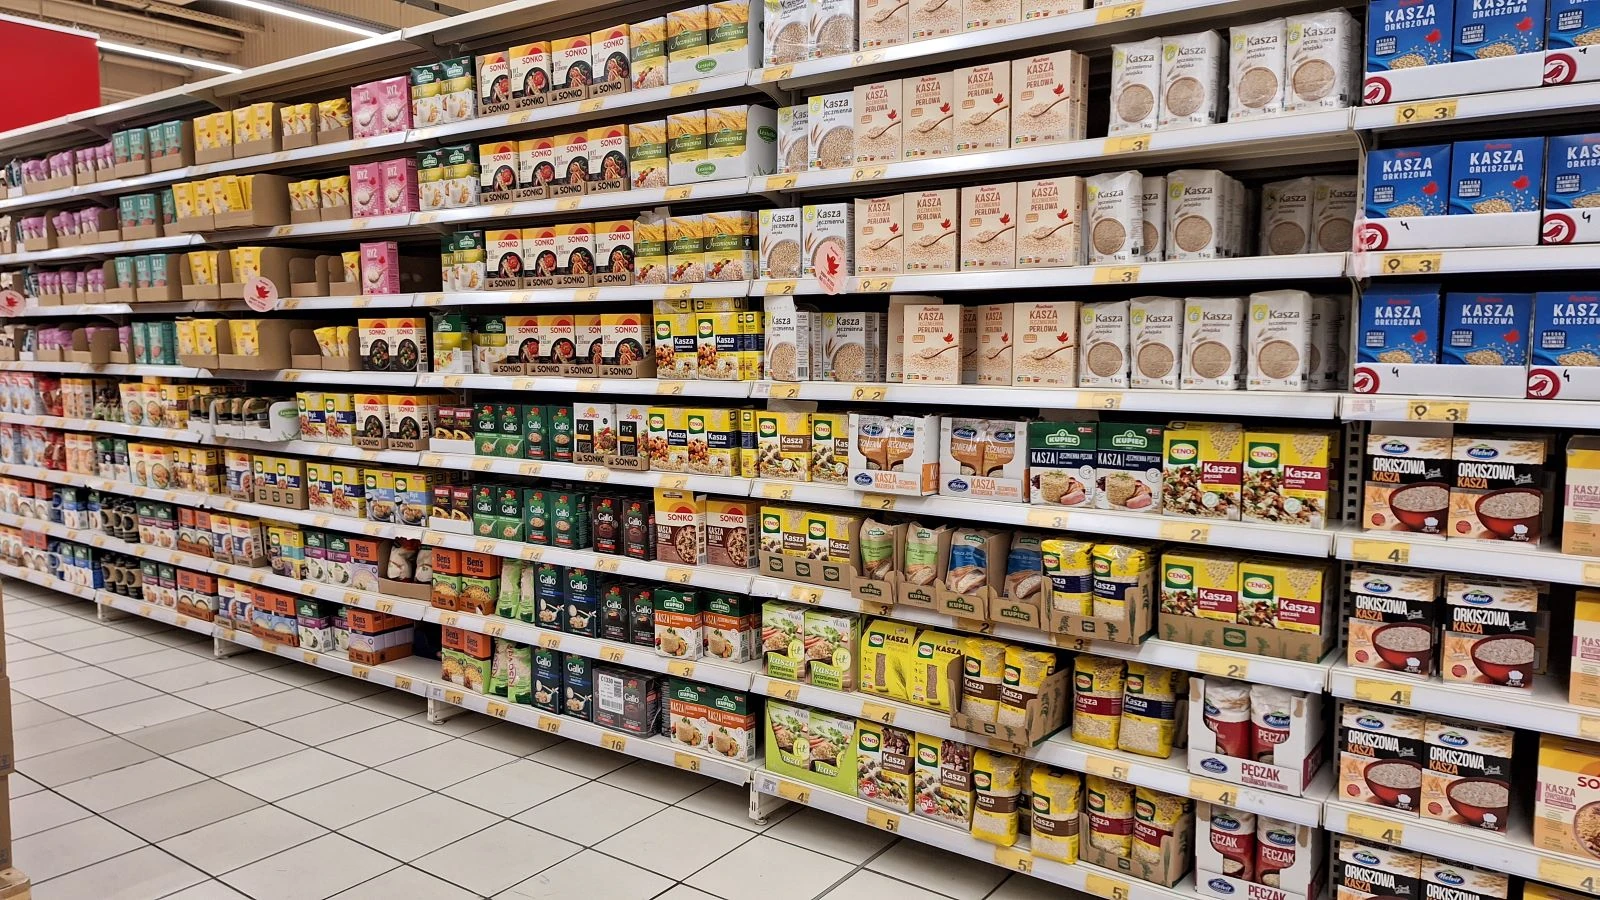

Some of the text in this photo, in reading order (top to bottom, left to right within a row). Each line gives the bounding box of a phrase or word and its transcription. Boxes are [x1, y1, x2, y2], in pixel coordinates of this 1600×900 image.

[1385, 4, 1435, 23] KASZA
[1385, 18, 1435, 31] ORKISZOWA
[1303, 27, 1336, 37] Kasza
[603, 39, 624, 49] SONKO
[1247, 35, 1278, 46] Kasza
[565, 48, 587, 57] SONKO
[1178, 47, 1206, 55] Kasza
[522, 56, 543, 65] SONKO
[1126, 54, 1154, 63] Kasza
[1027, 62, 1054, 74] KASZA
[916, 83, 940, 92] KASZA
[559, 89, 582, 100] SONKO
[824, 99, 848, 108] Kasza
[1434, 107, 1447, 119] 3
[601, 138, 622, 147] SONKO
[1132, 141, 1142, 150] 3
[1470, 150, 1523, 165] KASZA
[1383, 158, 1432, 172] KASZA
[1470, 163, 1523, 173] ORKISZOWA
[1383, 170, 1431, 180] ORKISZOWA
[1031, 188, 1058, 197] KASZA
[1184, 186, 1212, 195] Kasza
[917, 198, 941, 208] KASZA
[1419, 260, 1432, 272] 3
[1122, 272, 1132, 282] 3
[1030, 310, 1058, 320] KASZA
[1268, 310, 1300, 318] Kasza
[1375, 306, 1421, 318] KASZA
[1462, 304, 1514, 316] KASZA
[836, 316, 860, 326] Kasza
[918, 312, 944, 321] KASZA
[1095, 314, 1122, 322] Kasza
[1146, 314, 1173, 323] Kasza
[1202, 312, 1233, 320] Kasza
[1446, 409, 1459, 421] 3
[479, 421, 494, 431] Gallo
[555, 422, 568, 431] Gallo
[1171, 448, 1195, 456] CENOS
[1250, 450, 1276, 459] CENOS
[1203, 462, 1237, 474] Kasza
[1373, 457, 1426, 474] ORKISZOWA
[1285, 468, 1321, 480] Kasza
[1372, 471, 1400, 483] KASZA
[1458, 463, 1515, 480] ORKISZOWA
[1458, 477, 1488, 489] KASZA
[502, 505, 516, 515] Gallo
[882, 500, 890, 509] 2
[598, 514, 612, 522] Gallo
[668, 514, 693, 522] SONKO
[784, 533, 804, 542] Kasza
[1190, 530, 1200, 541] 2
[436, 553, 450, 563] Ben's
[1388, 550, 1400, 562] 4
[466, 557, 483, 567] Ben's
[540, 574, 556, 585] Gallo
[570, 580, 587, 591] Gallo
[860, 587, 881, 595] KUPIEC
[809, 594, 816, 603] 3
[909, 592, 931, 600] KUPIEC
[1200, 590, 1232, 602] Kasza
[607, 600, 621, 610] Gallo
[948, 601, 974, 612] KUPIEC
[1280, 600, 1315, 613] Kasza
[1356, 595, 1408, 615] ORKISZOWA
[353, 614, 365, 623] Ben's
[1003, 610, 1029, 620] KUPIEC
[1356, 609, 1383, 622] KASZA
[1454, 607, 1510, 627] ORKISZOWA
[980, 623, 989, 632] 2
[1453, 622, 1483, 634] KASZA
[547, 639, 557, 648] 19
[886, 634, 908, 644] KASZA
[536, 656, 552, 667] Gallo
[609, 652, 620, 661] 16
[568, 662, 584, 674] Gallo
[813, 665, 840, 676] kasza
[1228, 665, 1238, 676] 2
[785, 691, 792, 699] 4
[1390, 691, 1401, 704] 4
[882, 712, 889, 720] 4
[547, 723, 558, 731] 19
[611, 740, 621, 749] 16
[861, 735, 878, 746] CENOS
[1348, 729, 1399, 752] ORKISZOWA
[920, 750, 936, 760] CENOS
[1348, 744, 1374, 757] KASZA
[883, 753, 905, 765] Kasza
[1430, 747, 1484, 770] ORKISZOWA
[1112, 766, 1121, 778] 5
[1241, 763, 1280, 781] PĘCZAK
[1429, 761, 1458, 775] KASZA
[942, 770, 966, 782] Kasza
[1546, 783, 1576, 797] KASZA
[1218, 792, 1229, 804] 4
[887, 819, 893, 830] 5
[1381, 830, 1393, 842] 4
[1262, 848, 1294, 864] PĘCZAK
[1018, 860, 1027, 871] 5
[1345, 867, 1395, 889] ORKISZOWA
[1344, 878, 1371, 893] KASZA
[1581, 877, 1594, 891] 4
[1113, 887, 1122, 898] 5
